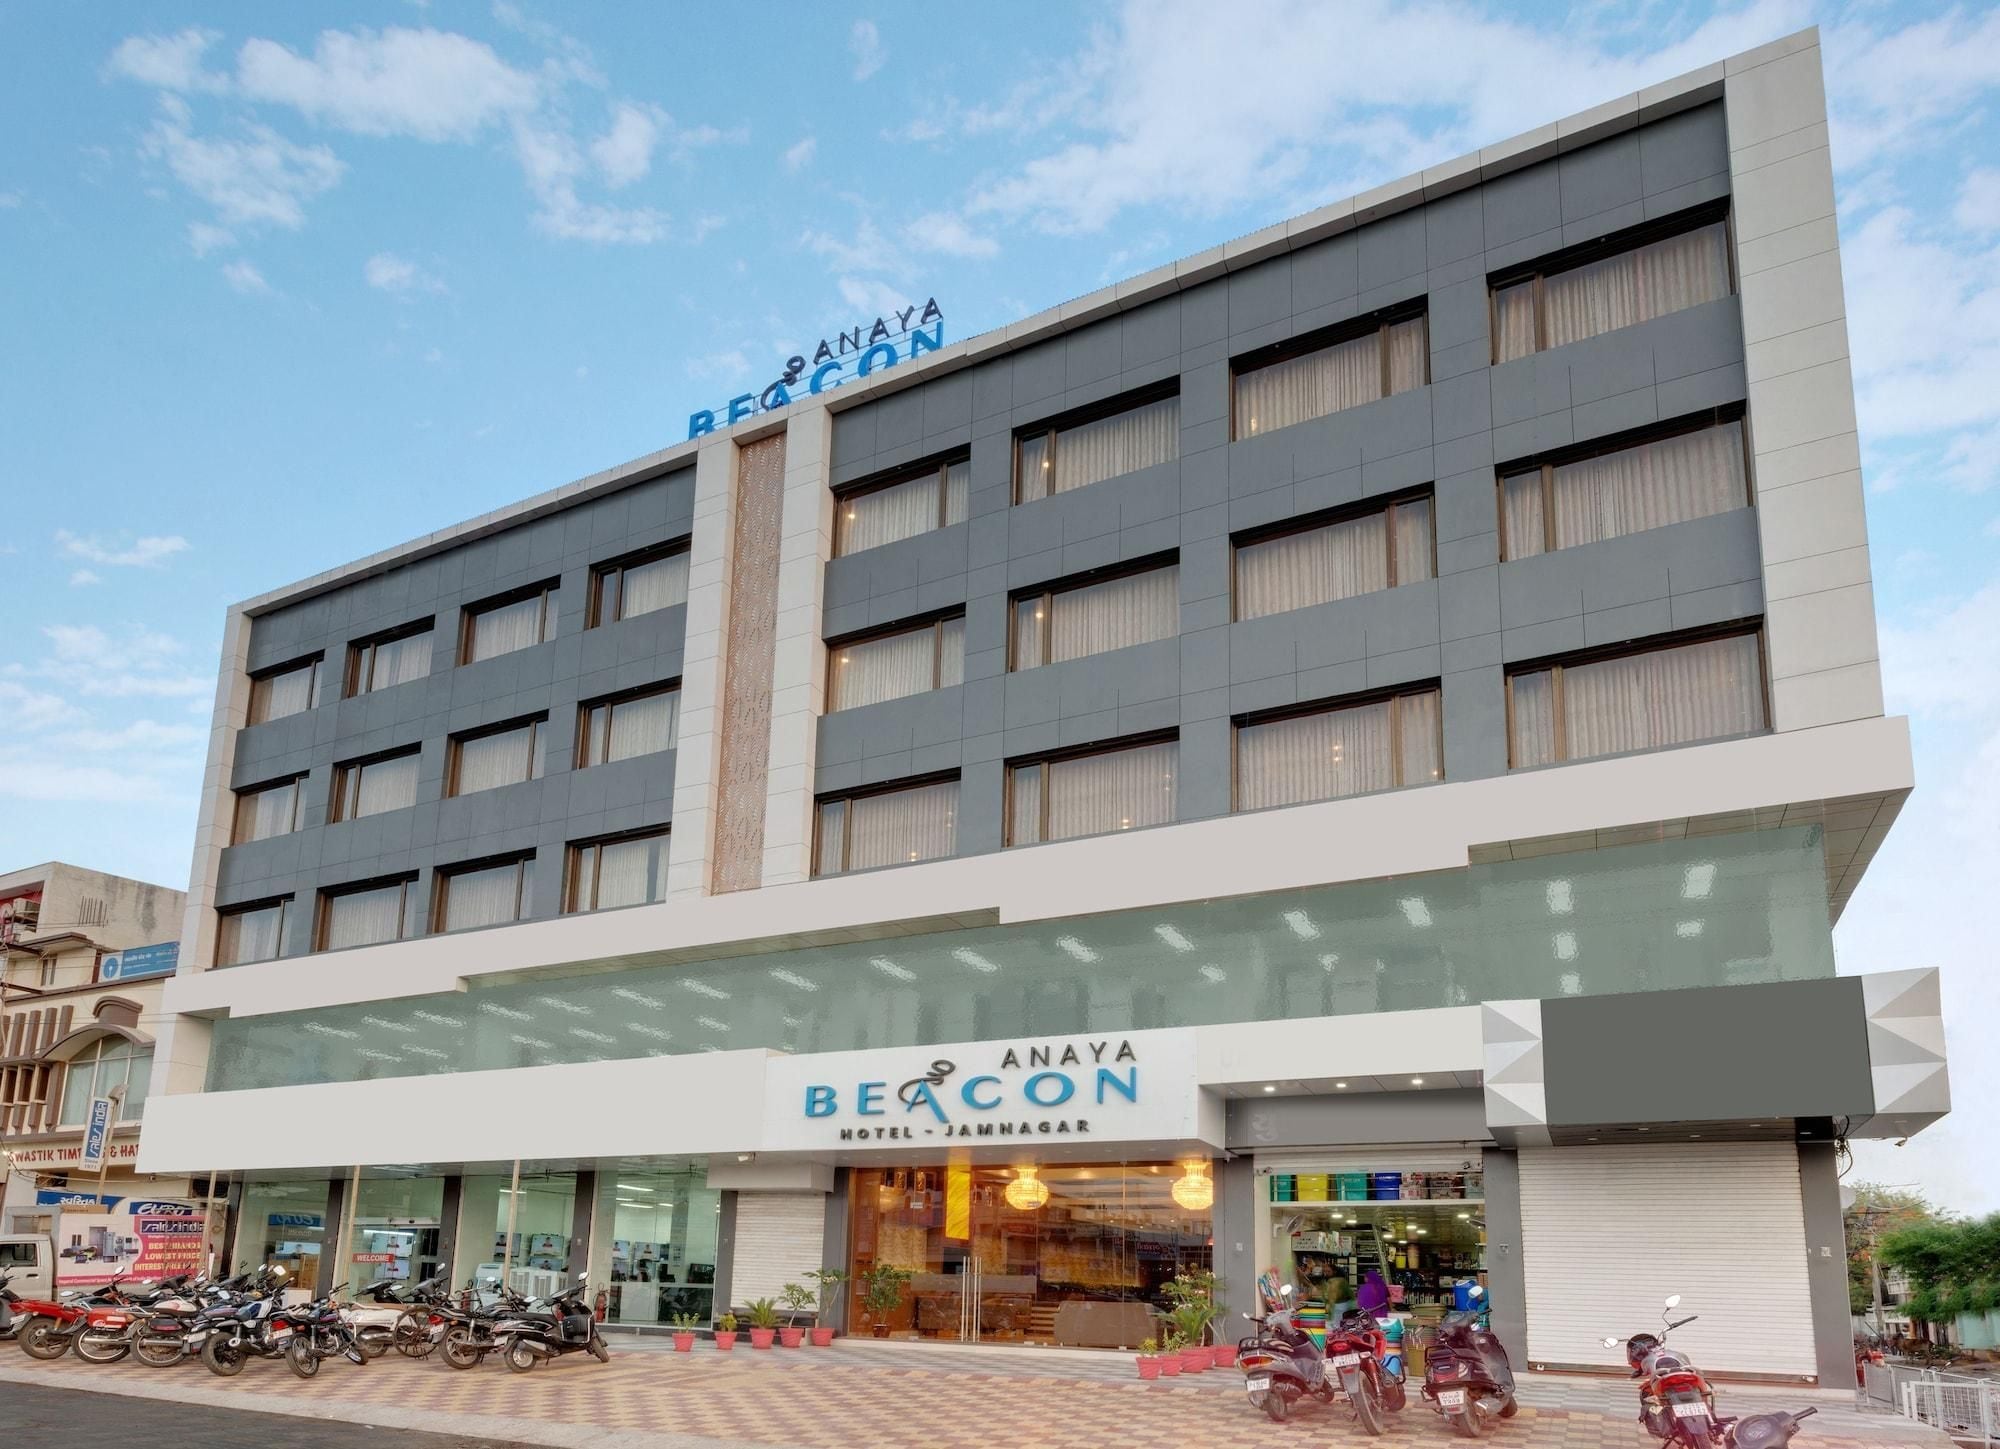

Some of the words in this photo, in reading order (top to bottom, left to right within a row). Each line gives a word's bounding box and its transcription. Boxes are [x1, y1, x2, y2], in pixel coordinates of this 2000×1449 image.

[812, 297, 943, 365] ANAYA
[688, 321, 944, 440] BEACON
[1001, 1039, 1137, 1070] ANAYA
[804, 1065, 1138, 1123] BEACON
[840, 1127, 913, 1141] HOTEL
[944, 1119, 1090, 1137] JAMNAGAR
[9, 1149, 54, 1162] SWASTIK
[110, 1145, 117, 1158] &
[357, 1254, 389, 1262] WELCOME
